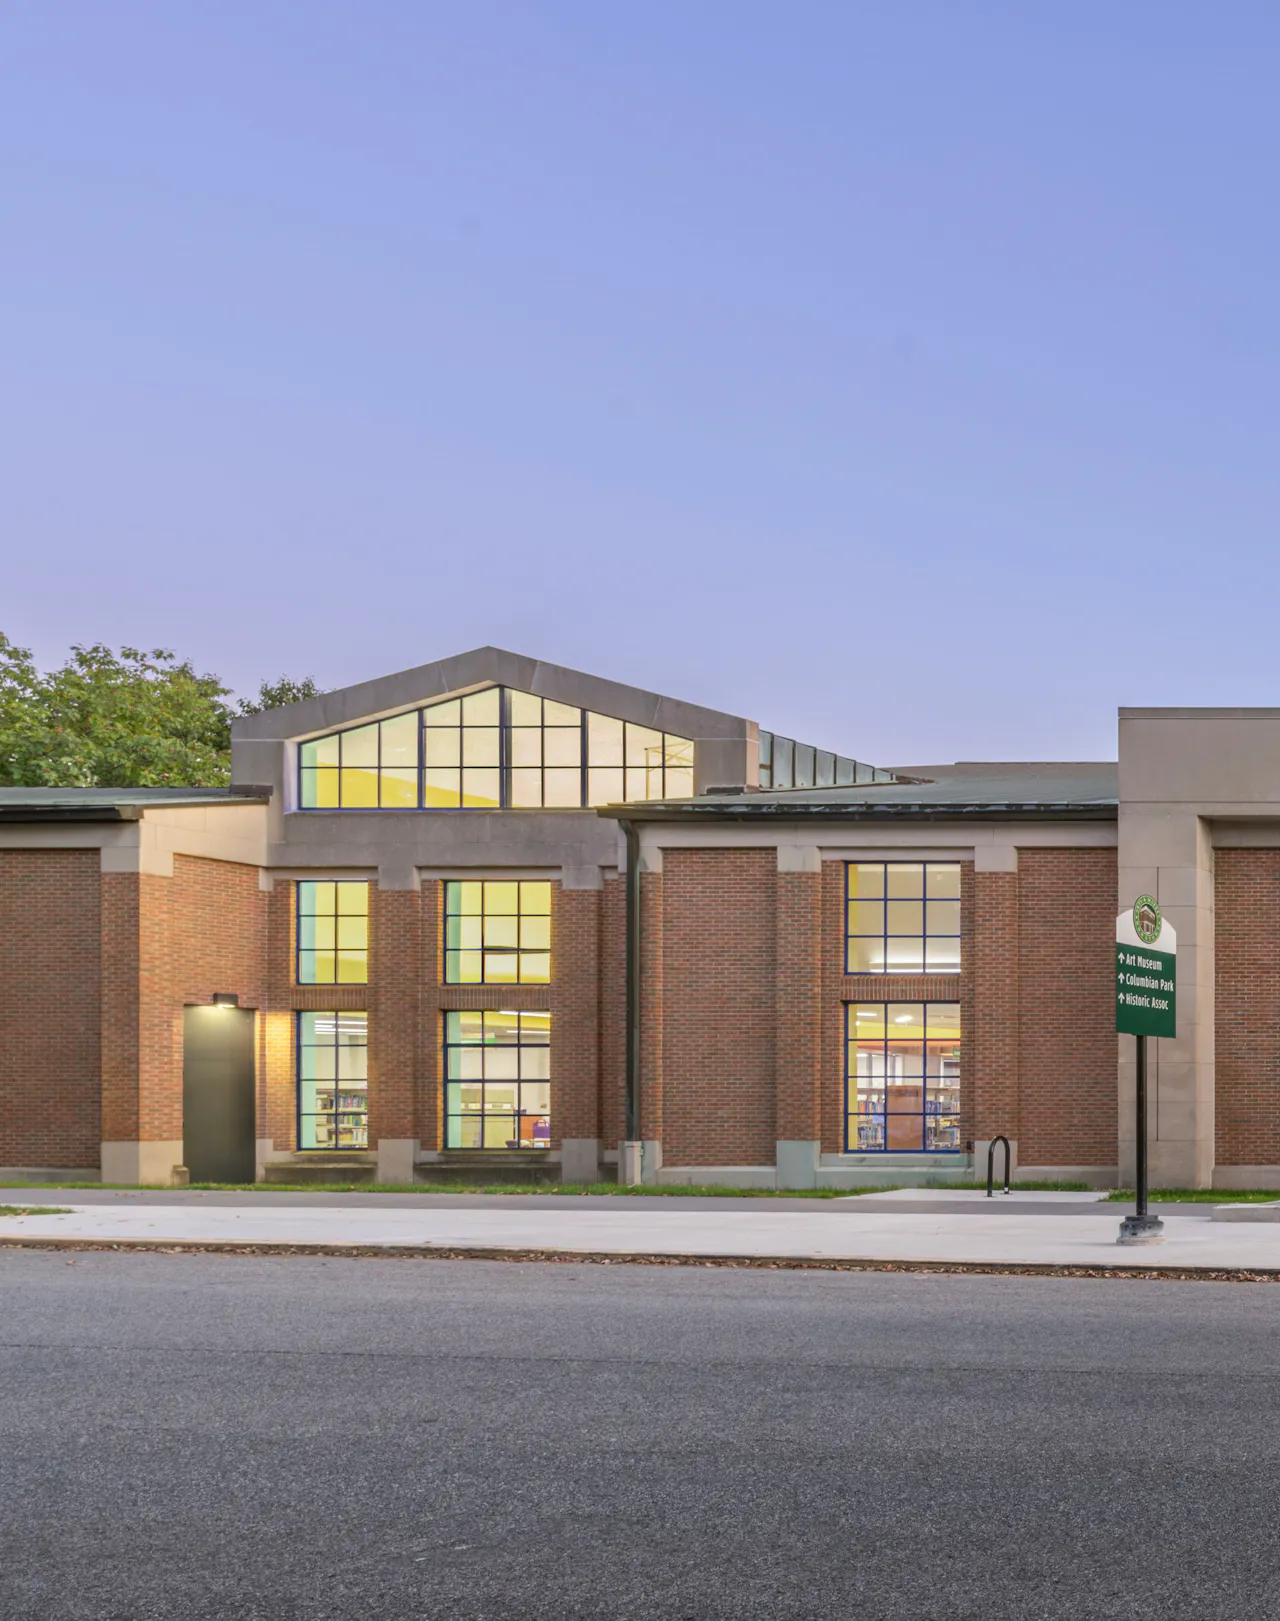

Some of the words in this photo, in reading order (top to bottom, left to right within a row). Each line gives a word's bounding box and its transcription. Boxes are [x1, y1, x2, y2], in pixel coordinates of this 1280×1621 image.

[1125, 953, 1136, 966] Art
[1137, 955, 1162, 970] Museum
[1125, 973, 1159, 989] Columbian
[1160, 979, 1174, 992] Park
[1125, 992, 1150, 1008] Historic
[1151, 997, 1169, 1010] Assoc
